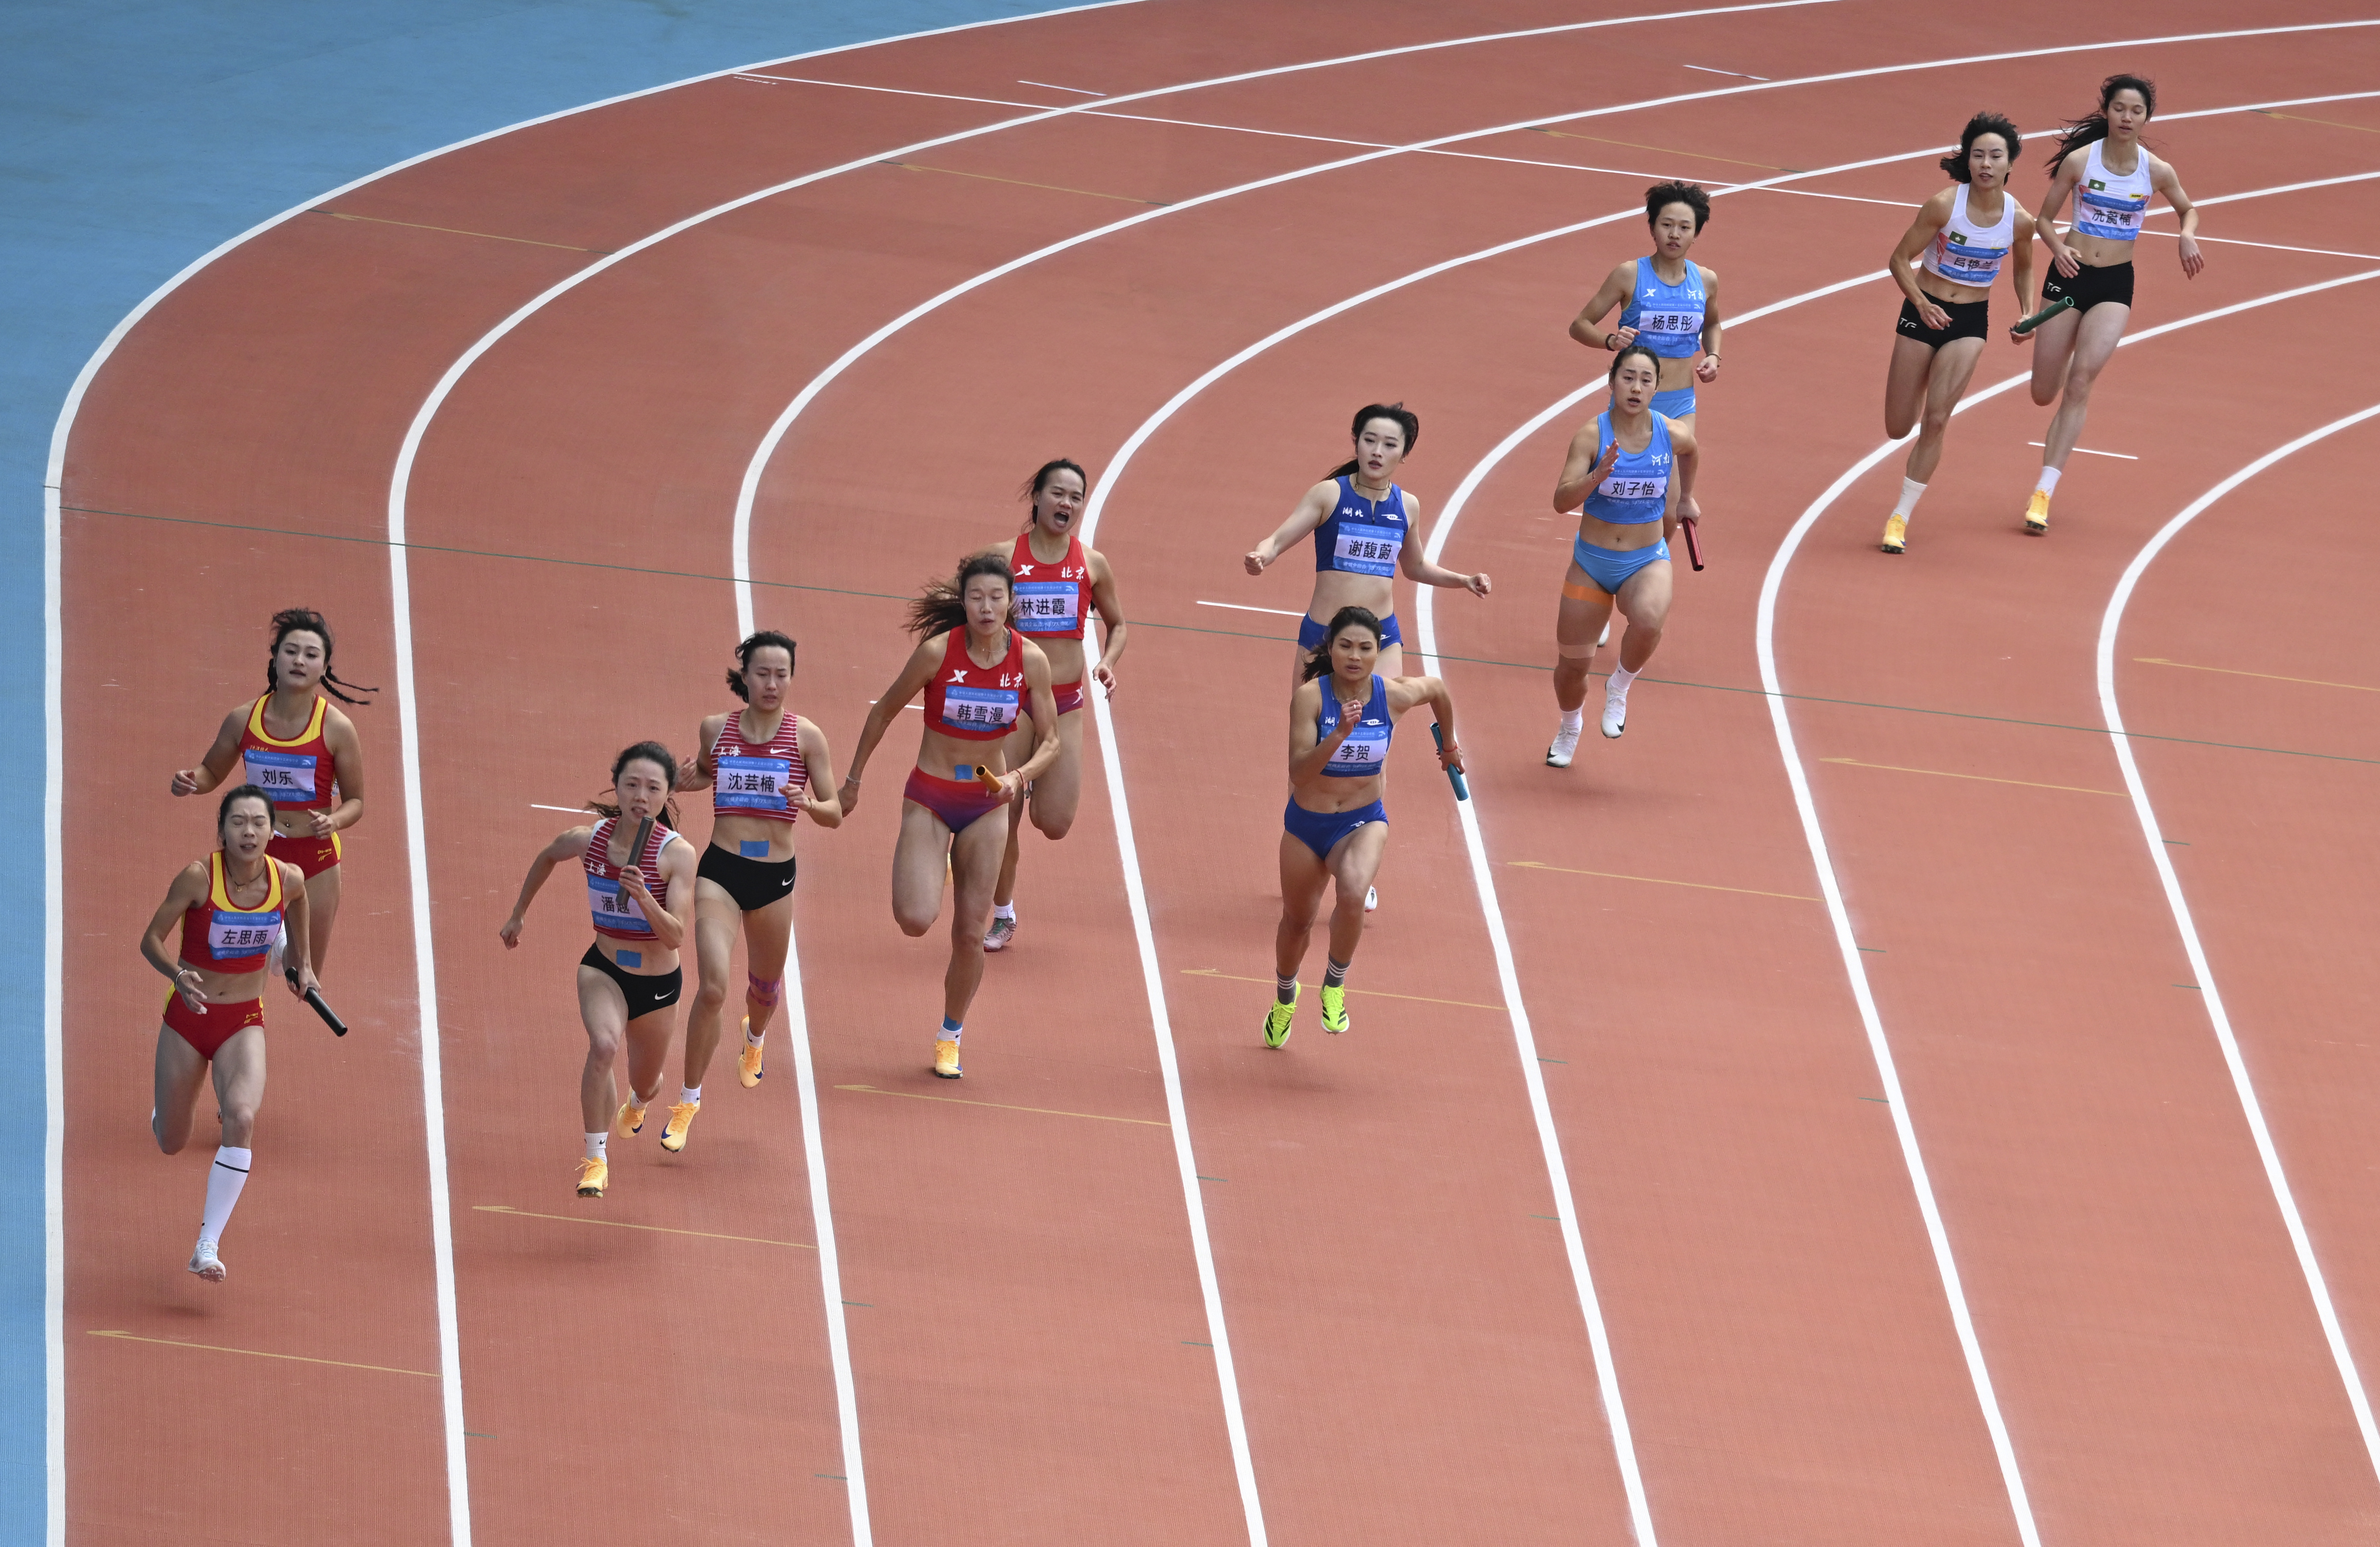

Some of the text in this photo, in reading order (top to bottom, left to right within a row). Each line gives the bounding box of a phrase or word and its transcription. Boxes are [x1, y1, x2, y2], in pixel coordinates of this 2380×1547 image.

[1652, 315, 1693, 331] 杨思彤
[1611, 481, 1655, 496] 刘子怡
[1342, 507, 1363, 517] 湖北
[1348, 539, 1392, 560] 谢馥蔚
[1061, 566, 1085, 580] 北京
[1020, 598, 1065, 616] 林进霞
[1000, 672, 1023, 688] 北京
[957, 703, 1003, 723] 韩雪漫
[1325, 716, 1339, 727] 湖
[718, 745, 741, 757] 上海
[1340, 744, 1370, 761] 李贺
[262, 768, 293, 785] 刘乐
[728, 773, 775, 792] 沈芸楠
[587, 862, 606, 876] 上海
[221, 929, 268, 945] 左思雨
